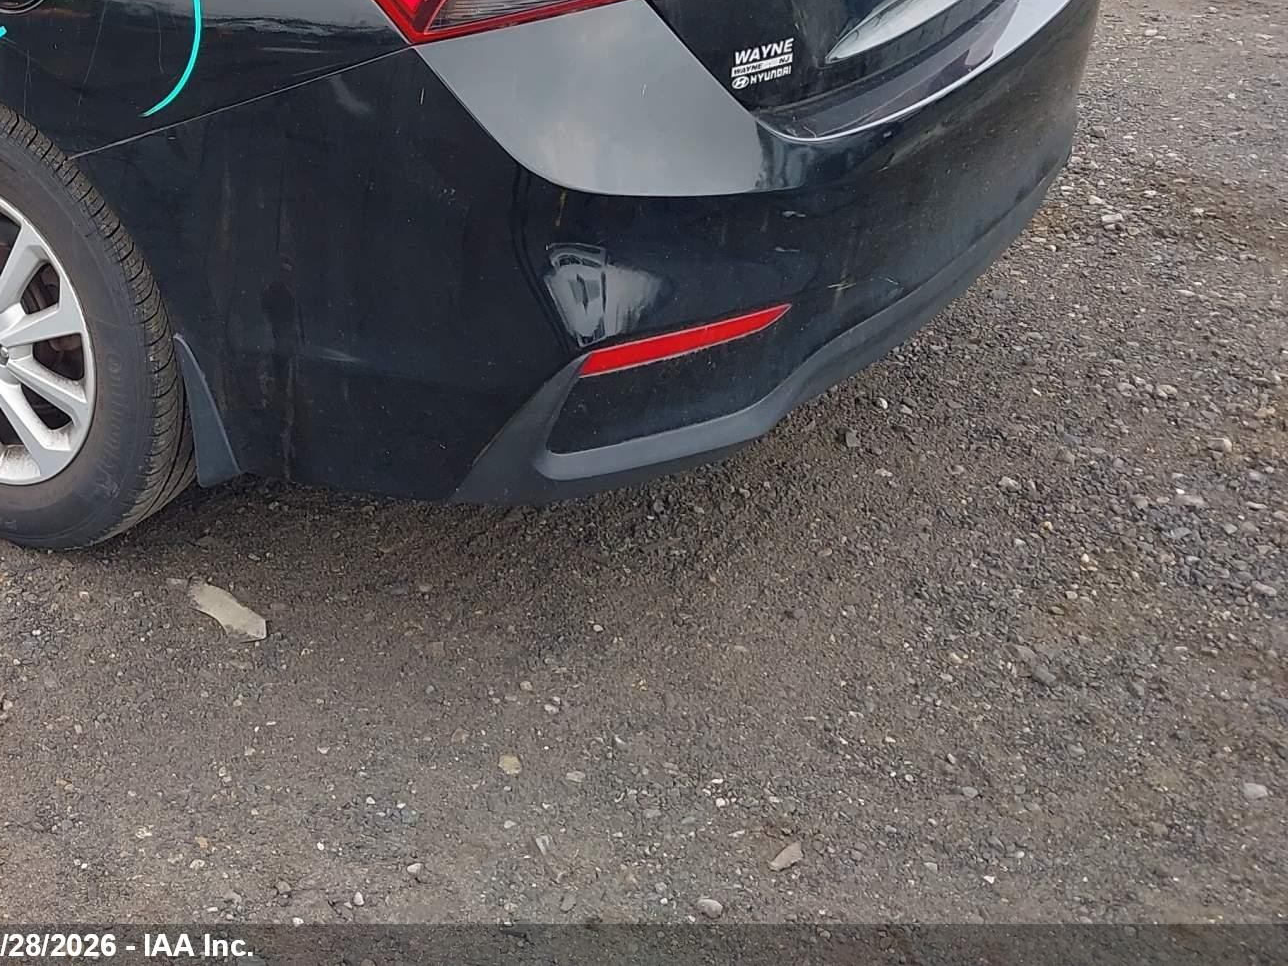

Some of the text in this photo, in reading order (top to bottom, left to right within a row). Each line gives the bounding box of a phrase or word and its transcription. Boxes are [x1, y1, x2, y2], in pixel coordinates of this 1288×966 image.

[735, 37, 794, 65] WAYNE
[733, 55, 791, 74] WAYNE NJ
[750, 65, 792, 85] HYUNDAI
